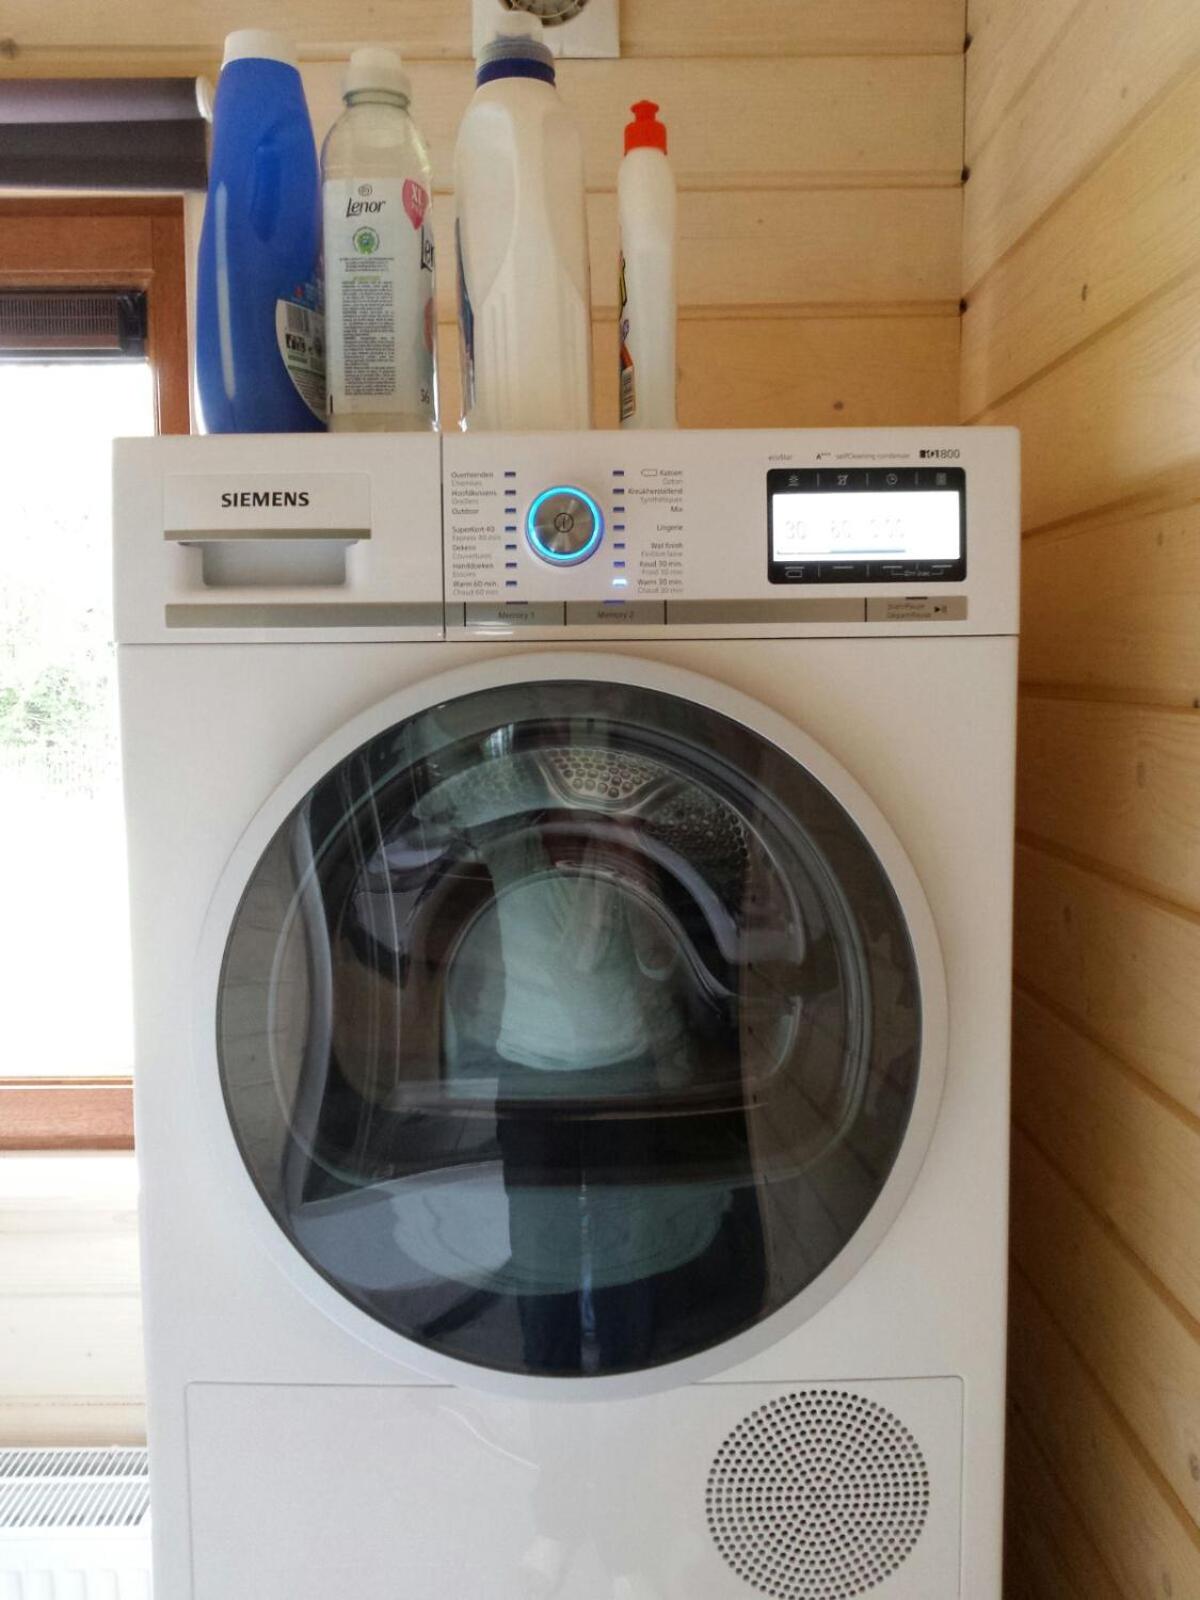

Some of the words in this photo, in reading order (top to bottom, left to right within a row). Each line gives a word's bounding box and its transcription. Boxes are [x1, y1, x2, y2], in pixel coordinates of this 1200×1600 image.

[346, 197, 387, 218] Lenor
[221, 491, 310, 508] SIEMENS
[499, 610, 528, 620] Memory
[597, 610, 627, 619] Memory
